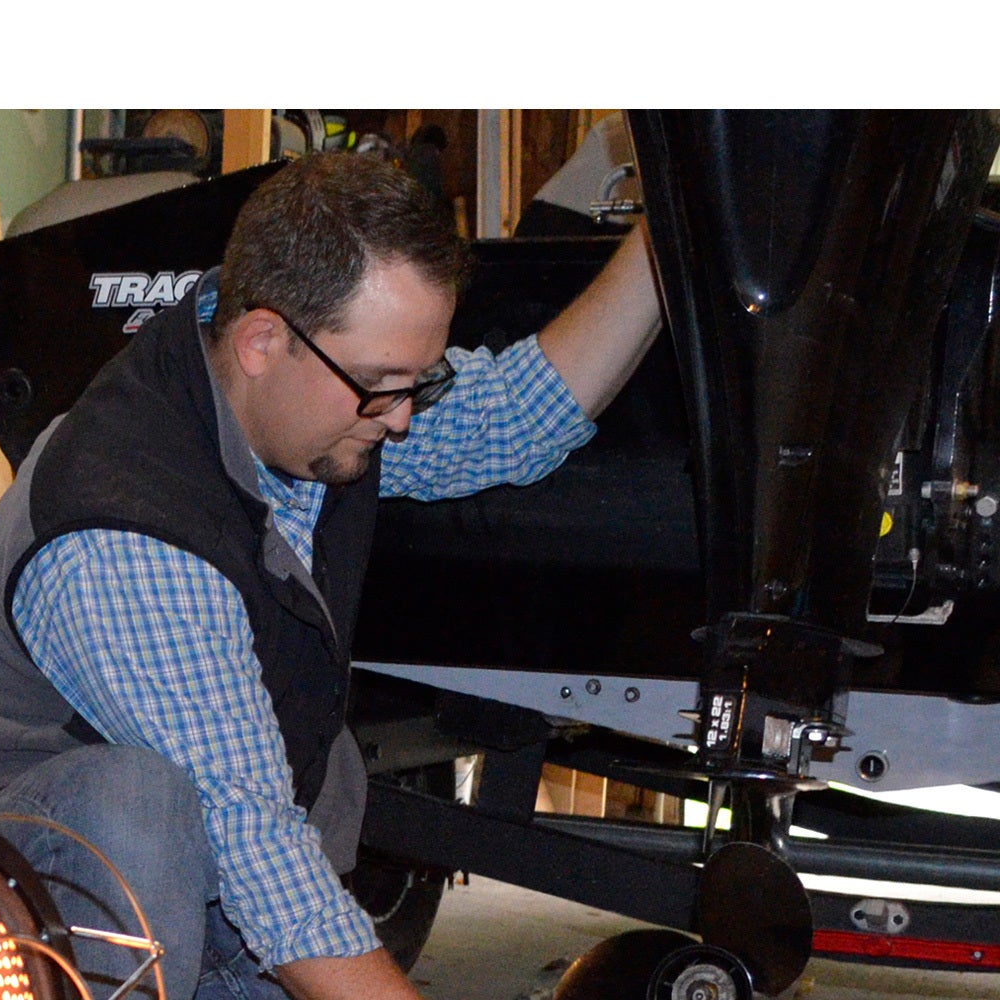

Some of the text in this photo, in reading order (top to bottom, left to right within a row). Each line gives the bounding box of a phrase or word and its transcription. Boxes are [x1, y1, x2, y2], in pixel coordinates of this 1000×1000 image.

[711, 695, 723, 717] 22
[719, 701, 733, 741] 1.83:1
[706, 729, 718, 748] 12
